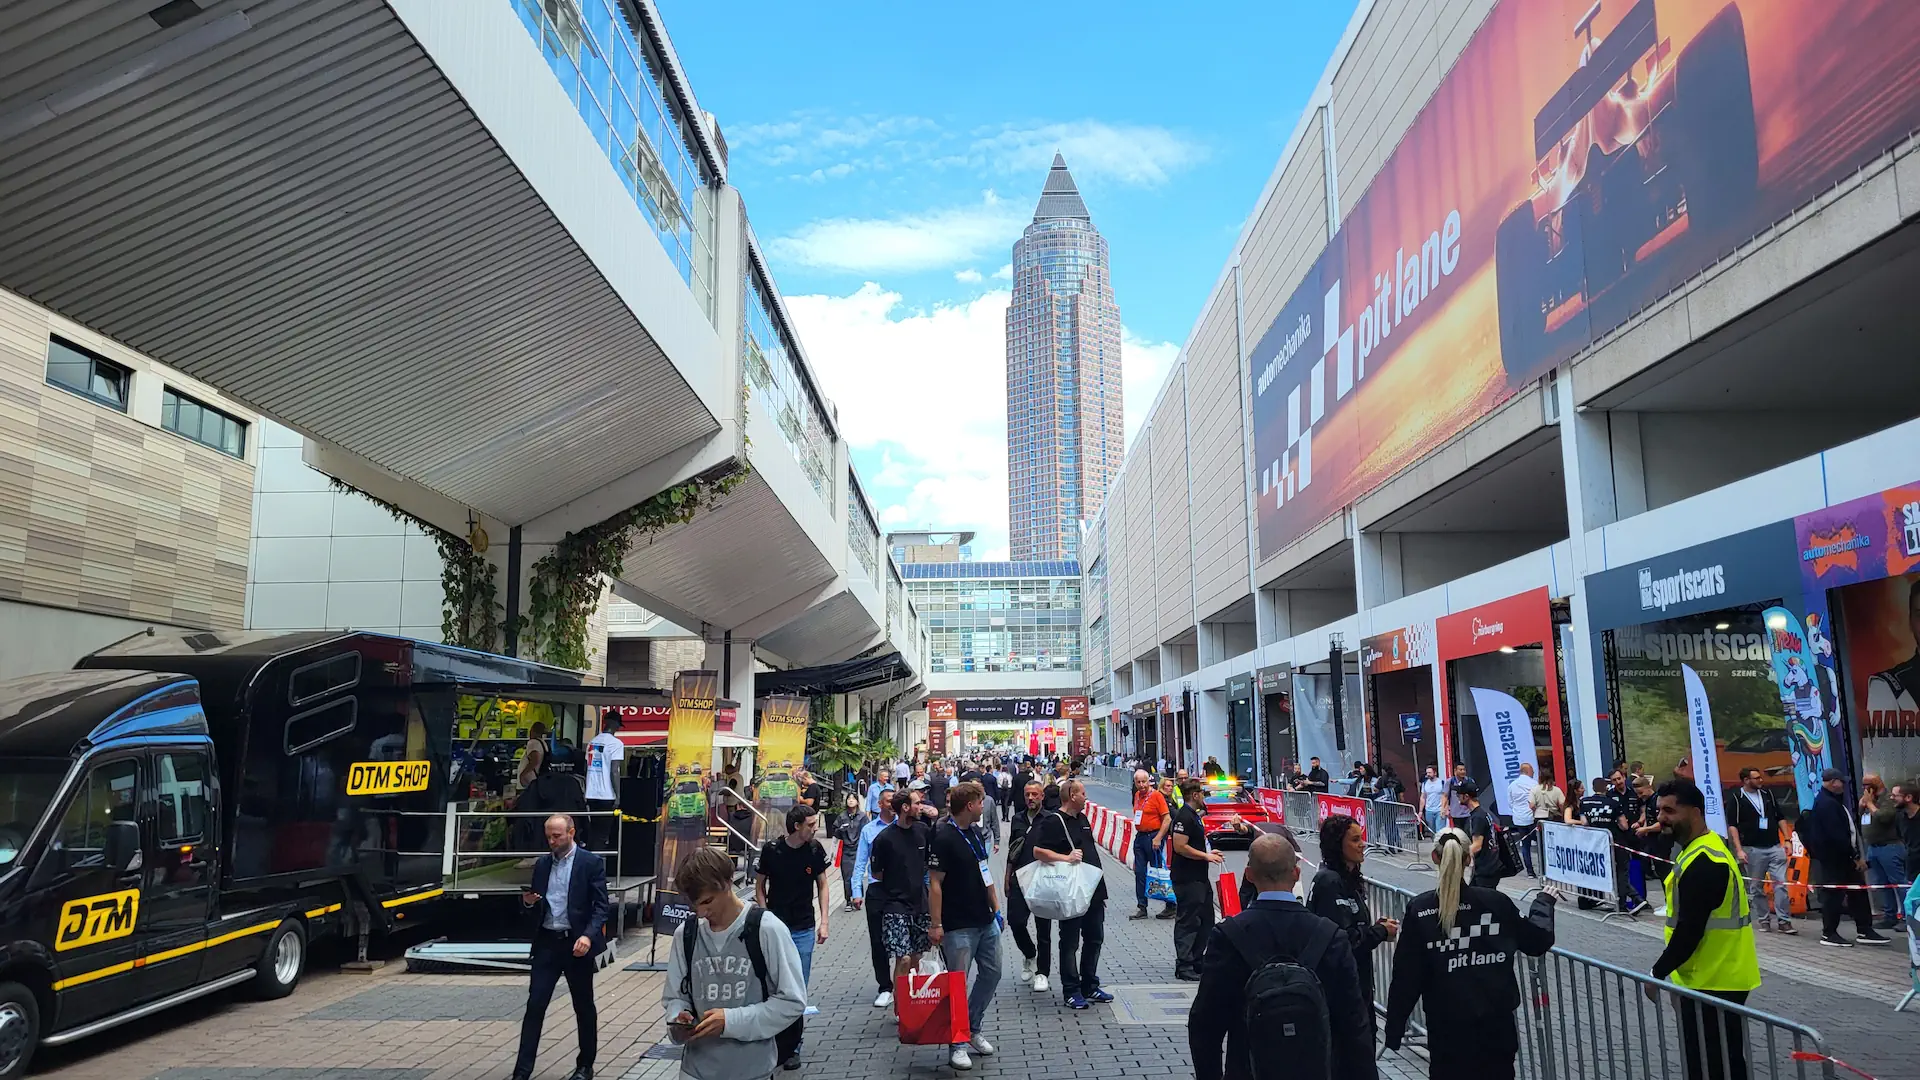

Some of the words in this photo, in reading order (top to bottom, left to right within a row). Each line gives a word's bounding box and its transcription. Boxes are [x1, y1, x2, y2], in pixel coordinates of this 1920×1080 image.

[1359, 269, 1392, 381] pit
[1395, 209, 1461, 328] lane
[1257, 313, 1311, 397] automechanika
[1803, 533, 1870, 560] automechanika
[1652, 565, 1726, 611] sportscars
[679, 699, 694, 707] DTM
[694, 700, 713, 709] SHOP
[786, 716, 805, 724] SHOP
[1862, 710, 1920, 738] MAR
[351, 766, 390, 789] DTM
[393, 765, 428, 788] SHOP
[1556, 844, 1605, 878] sportscars
[60, 896, 132, 943] DTM
[1448, 953, 1468, 972] pit
[1470, 951, 1506, 966] lane
